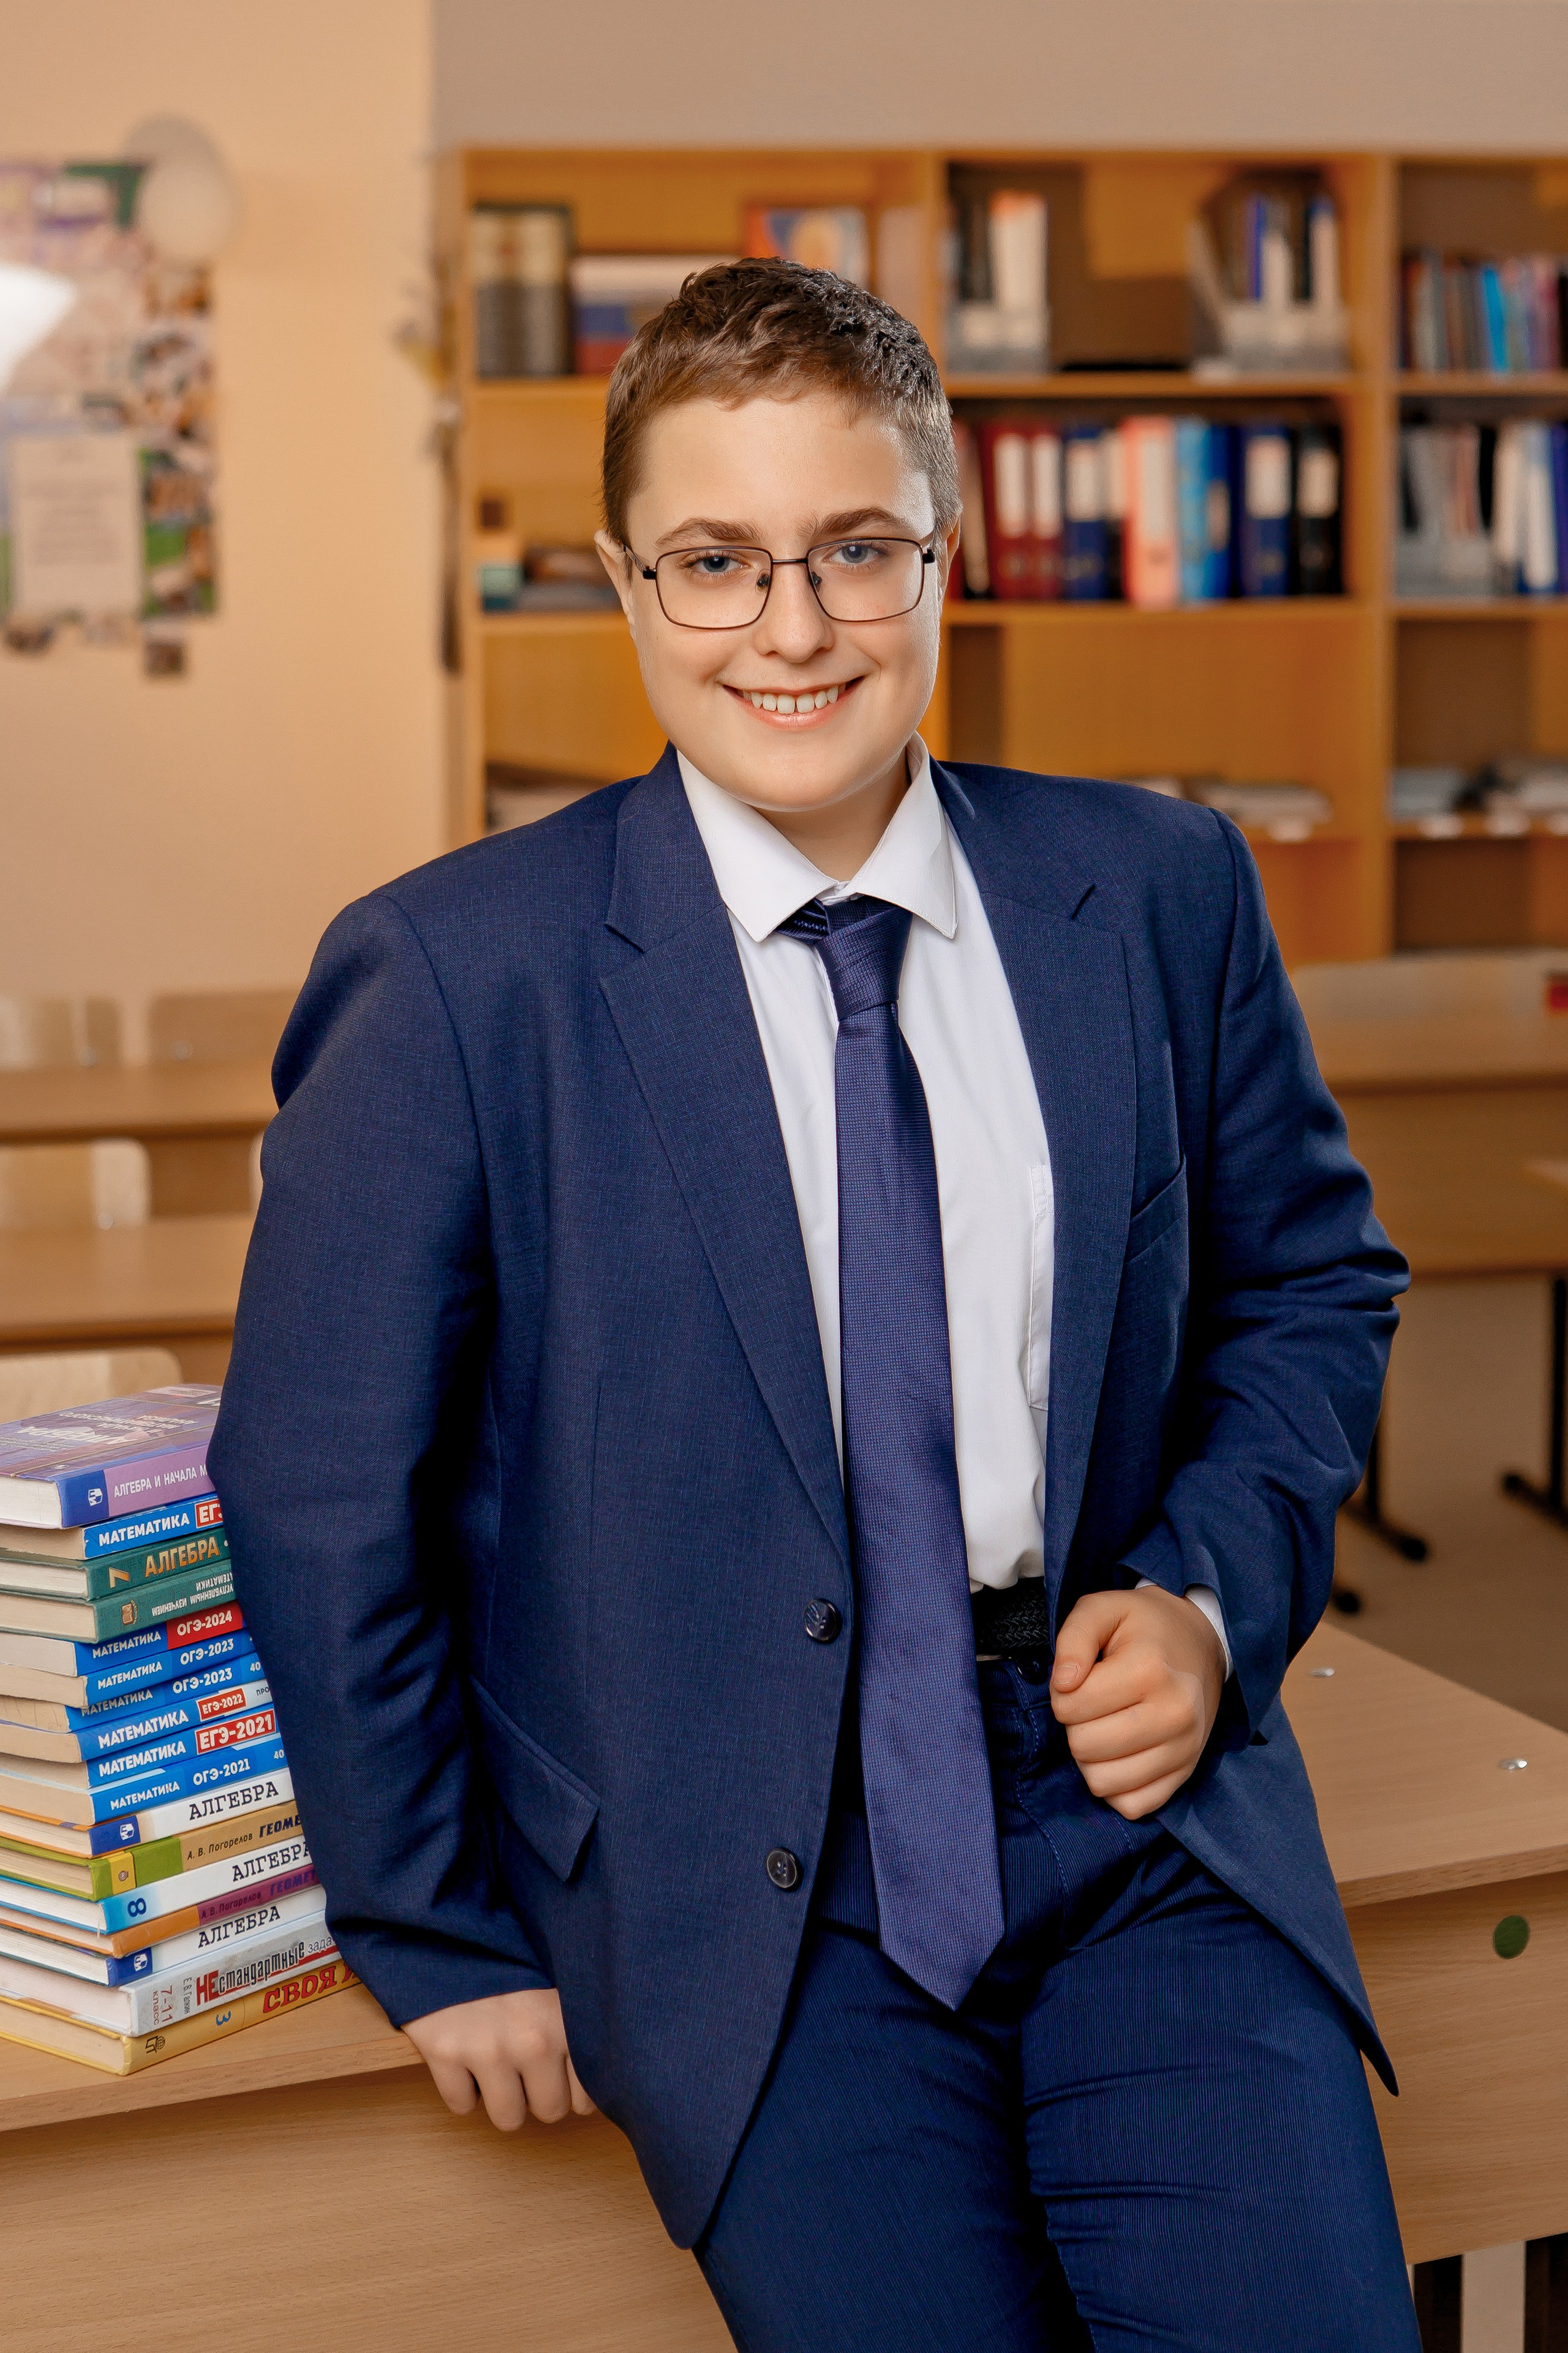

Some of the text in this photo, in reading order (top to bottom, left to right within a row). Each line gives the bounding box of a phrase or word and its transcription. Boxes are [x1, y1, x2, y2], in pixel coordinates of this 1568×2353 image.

[114, 1477, 152, 1498] АЛГЕБРА
[154, 1475, 161, 1488] И
[164, 1467, 197, 1486] НАЧАЛА
[99, 1513, 190, 1547] МАТЕМАТИКА
[108, 1566, 130, 1588] 7
[145, 1536, 220, 1578] АЛГЕБРА
[151, 1583, 234, 1617] УГЛУБЛЕННЫМ ИЗУЧЕНИЕМ
[92, 1610, 232, 1659] МАТЕМАТИКА ОГЭ-2024
[97, 1638, 234, 1690] МАТЕМАТИКА ОГЭ-2023
[81, 1661, 261, 1717] МАТЕМАТИКА ОГЭ-2023 40
[98, 1686, 270, 1750] МАТЕМАТИКА ЕГЭ-2022 ПРО
[99, 1713, 273, 1777] МАТЕМАТИКА ЕГЭ-2021
[110, 1749, 285, 1811] МАТЕМАТИКА ОГЭ-2021 40
[189, 1781, 279, 1821] АЛГЕБРА
[187, 1815, 301, 1860] А. В. Погорелов ГЕОМЕ
[127, 1897, 147, 1917] 8
[219, 1891, 262, 1913] Погорелов
[198, 1906, 281, 1948] АЛГЕБРА
[196, 1941, 305, 2006] НЕстандартные
[263, 1965, 337, 2014] СВОЯ
[161, 1985, 173, 2022] 7-11
[216, 2010, 232, 2026] 3
